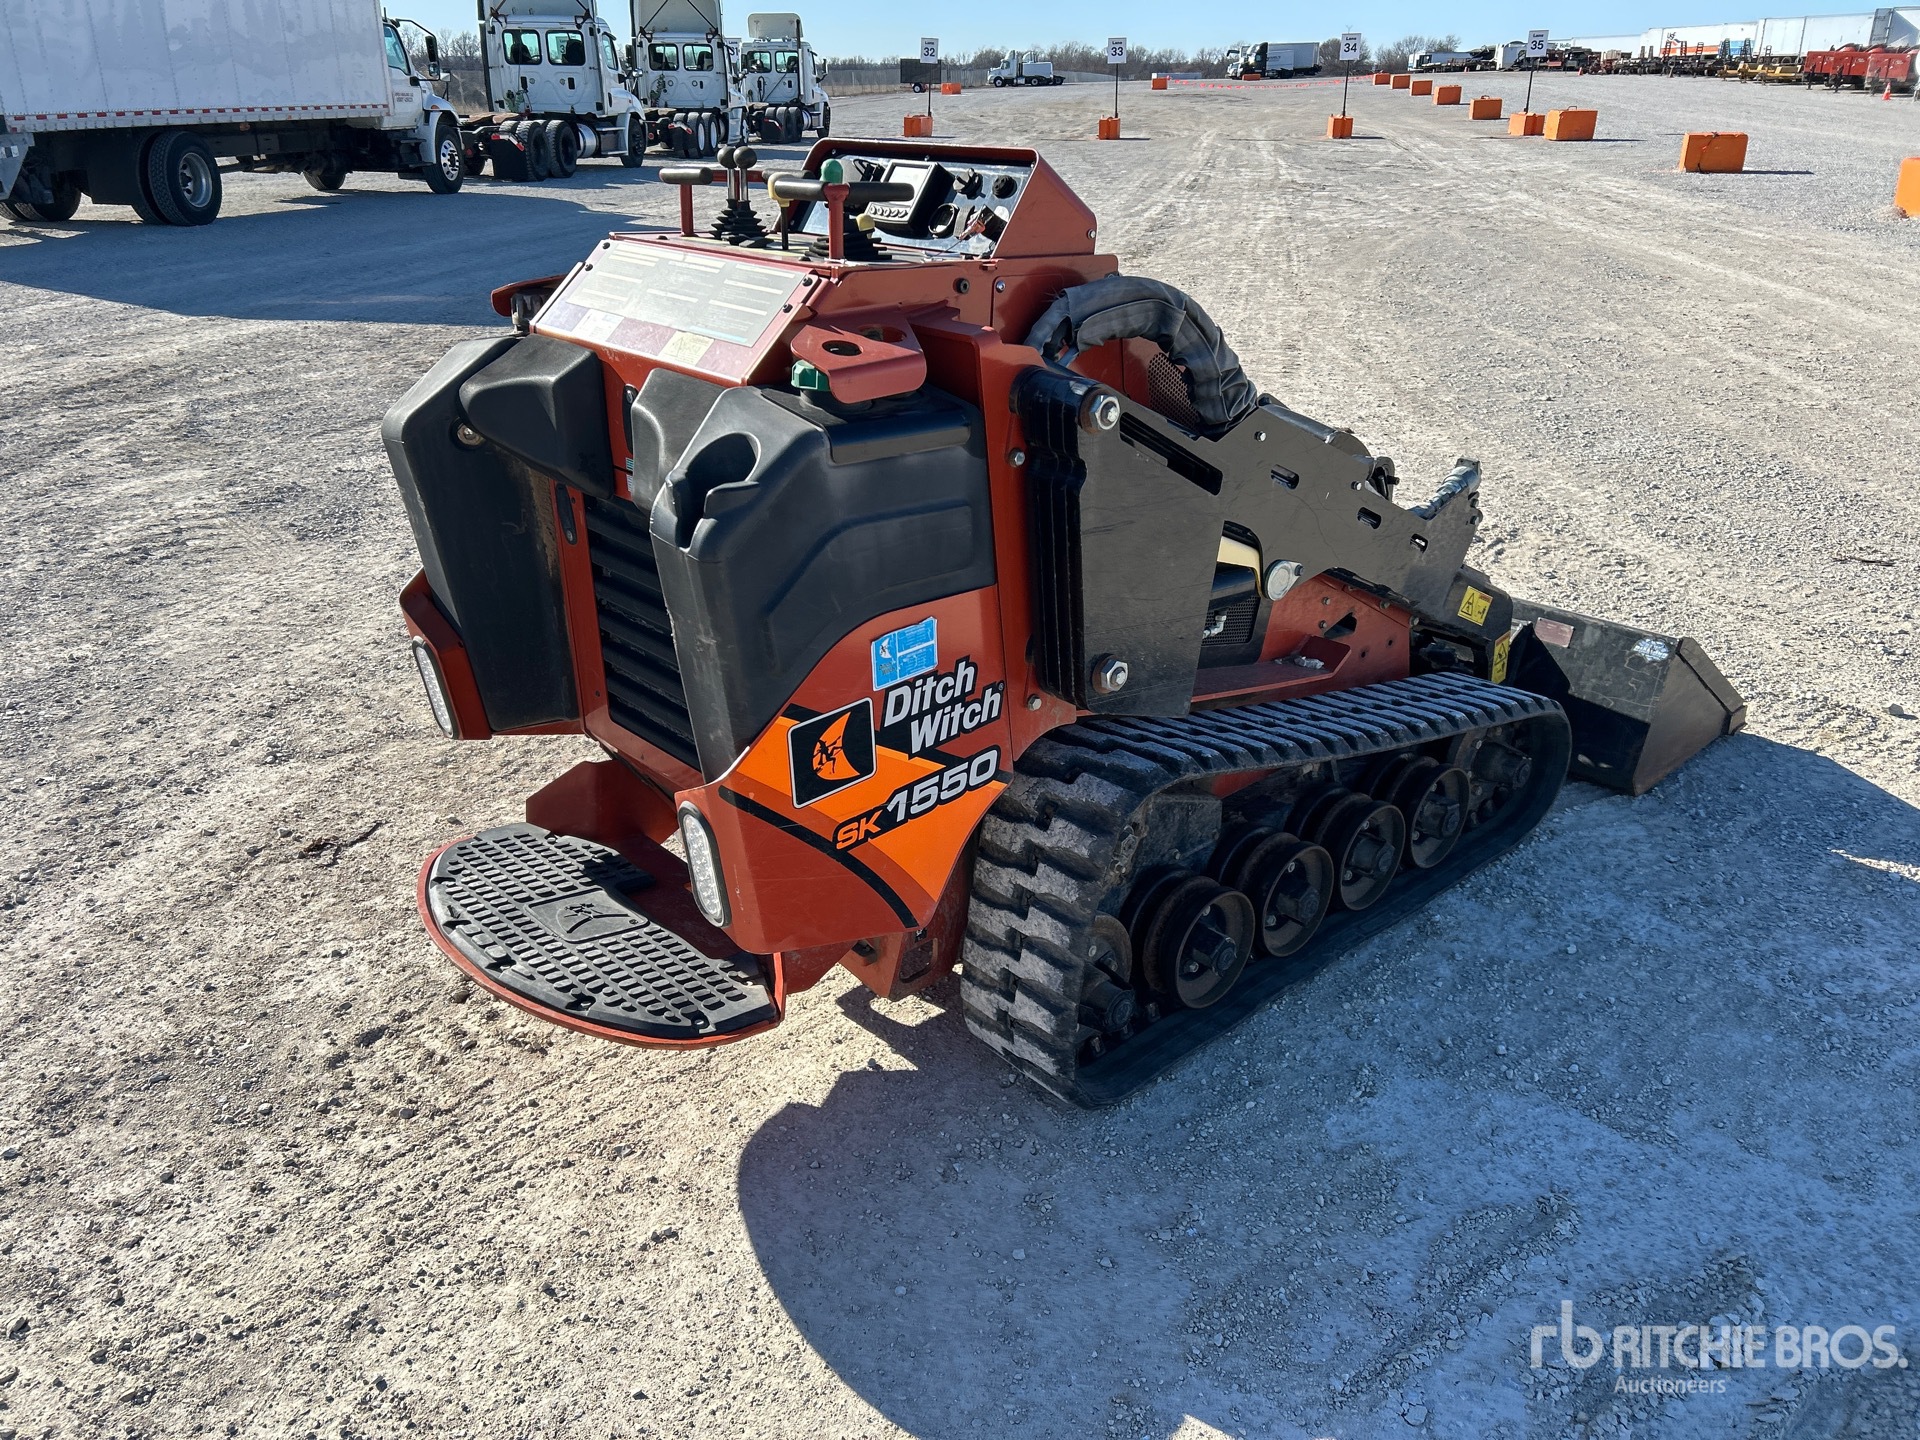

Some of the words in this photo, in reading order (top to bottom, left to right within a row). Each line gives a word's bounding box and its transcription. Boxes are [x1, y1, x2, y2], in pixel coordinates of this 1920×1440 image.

[1343, 42, 1357, 52] 34
[1530, 40, 1544, 50] 35
[923, 46, 935, 57] 32
[1111, 46, 1123, 56] 33
[884, 661, 975, 728] Ditch
[910, 688, 1001, 754] Witch
